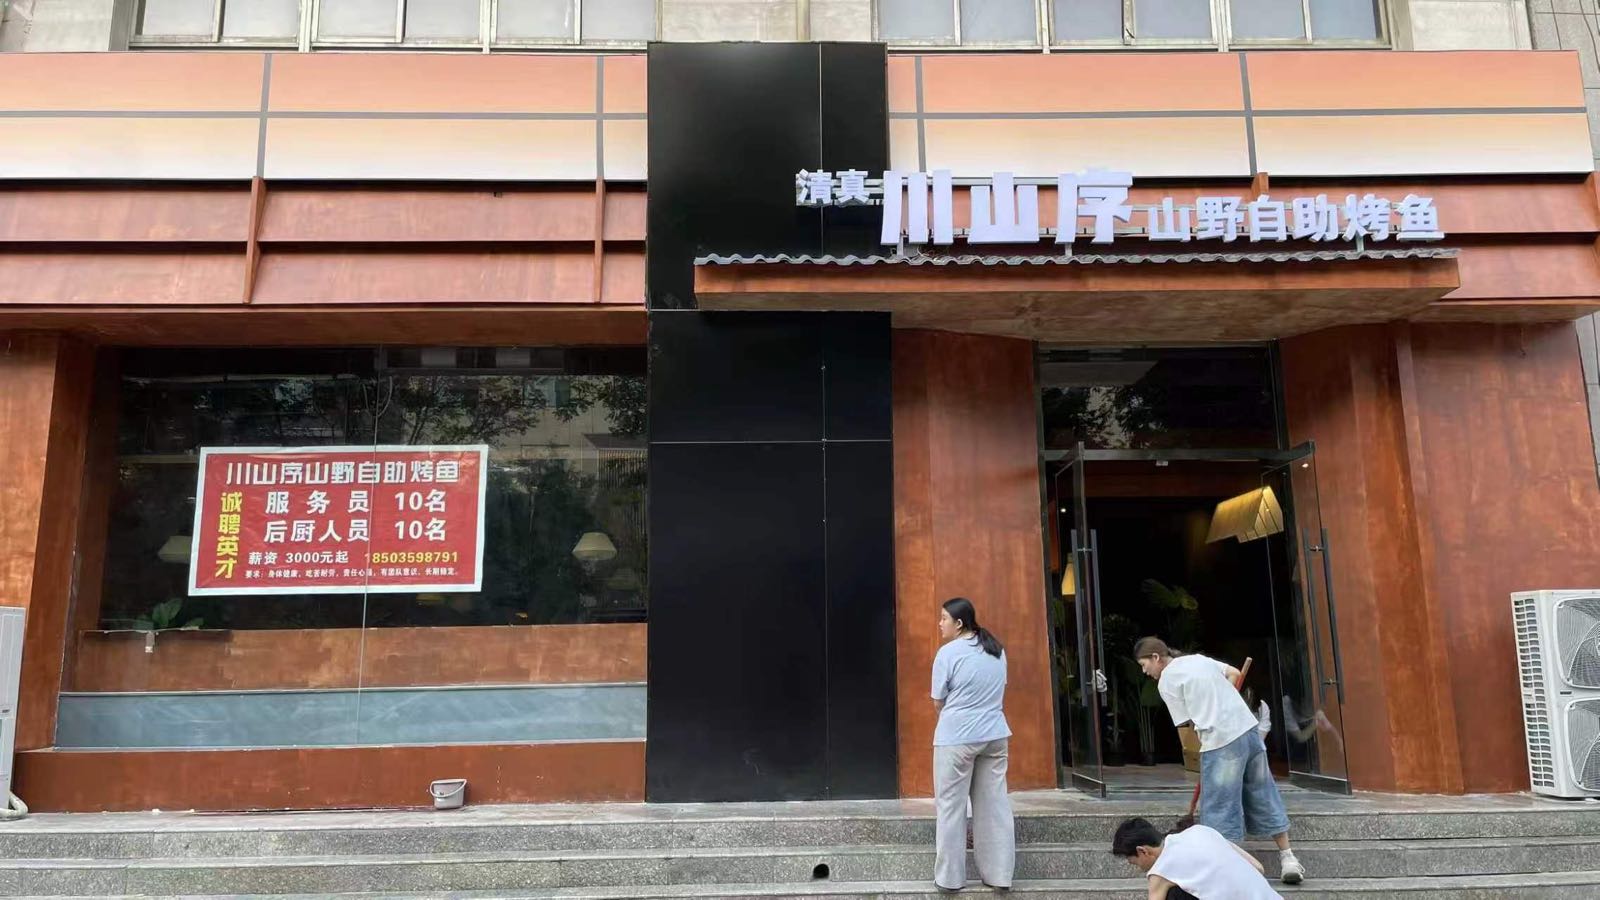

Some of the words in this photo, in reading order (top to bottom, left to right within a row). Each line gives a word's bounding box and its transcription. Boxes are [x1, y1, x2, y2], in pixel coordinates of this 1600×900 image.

[796, 168, 869, 206] 清真
[881, 168, 1133, 244] 川山序
[1148, 193, 1445, 243] 山野自助烤鱼
[226, 460, 459, 485] 川山序山野自助烤鱼
[265, 491, 370, 513] 服务员
[394, 489, 446, 513] 10名
[215, 491, 242, 579] 诚聘英才
[264, 519, 370, 543] 后厨人员
[394, 519, 446, 542] 10名
[248, 552, 278, 565] 薪资
[285, 550, 349, 565] 3000元起
[364, 551, 457, 564] 18503598791
